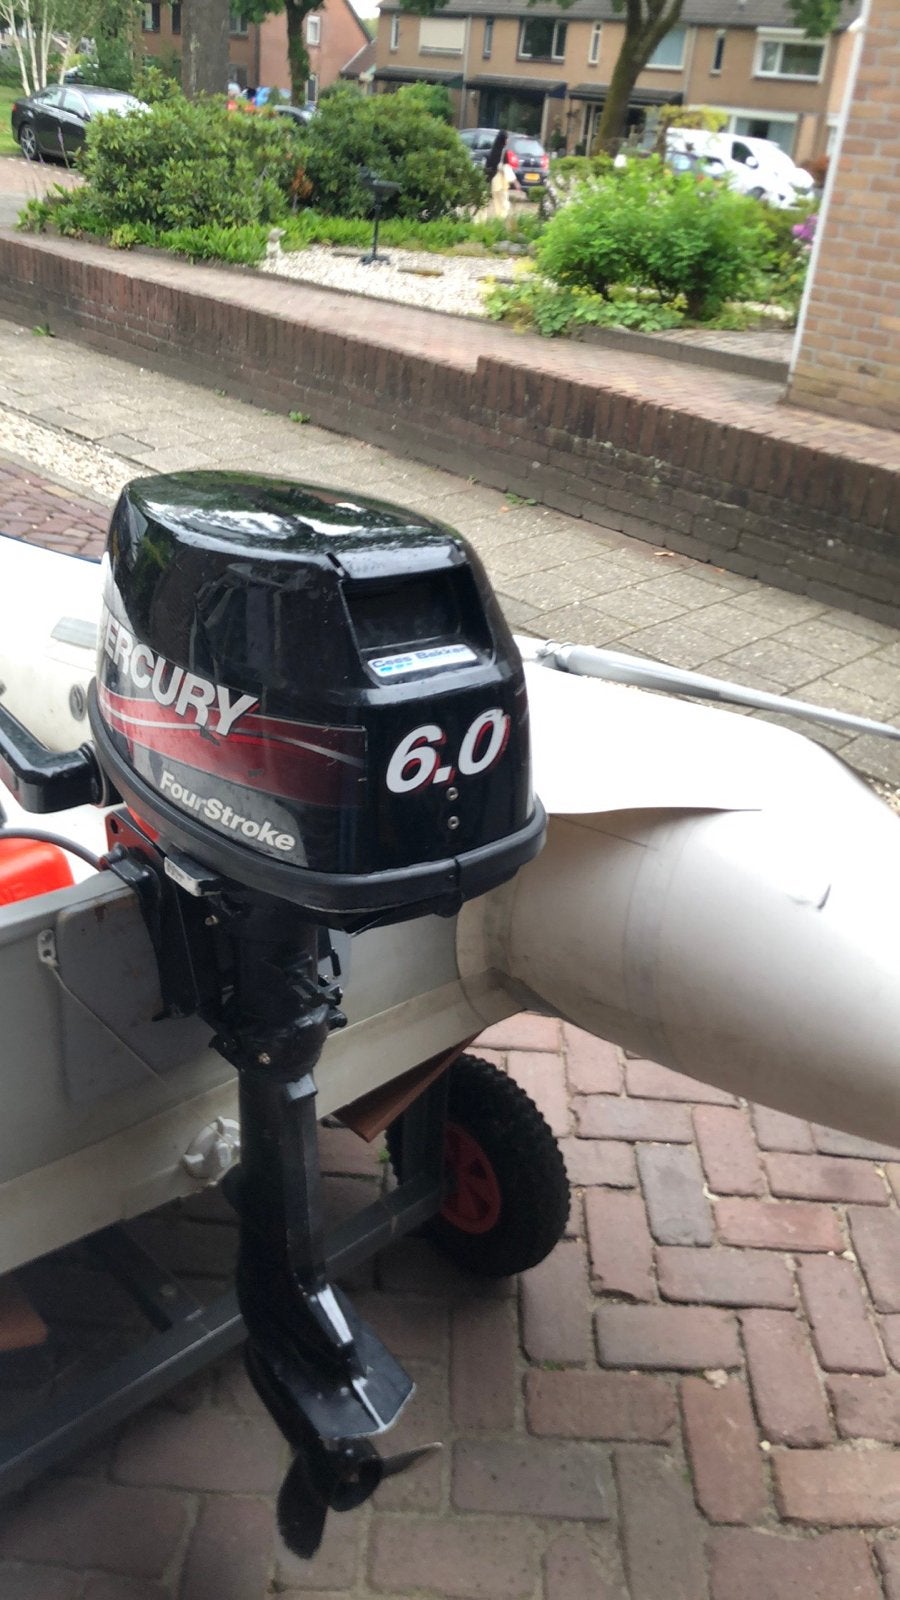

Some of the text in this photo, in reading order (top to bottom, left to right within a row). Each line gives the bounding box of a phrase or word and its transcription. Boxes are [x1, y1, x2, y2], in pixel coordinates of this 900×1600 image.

[102, 614, 258, 736] ERCURY
[386, 708, 510, 794] 6.0
[160, 771, 296, 851] FourStroke
